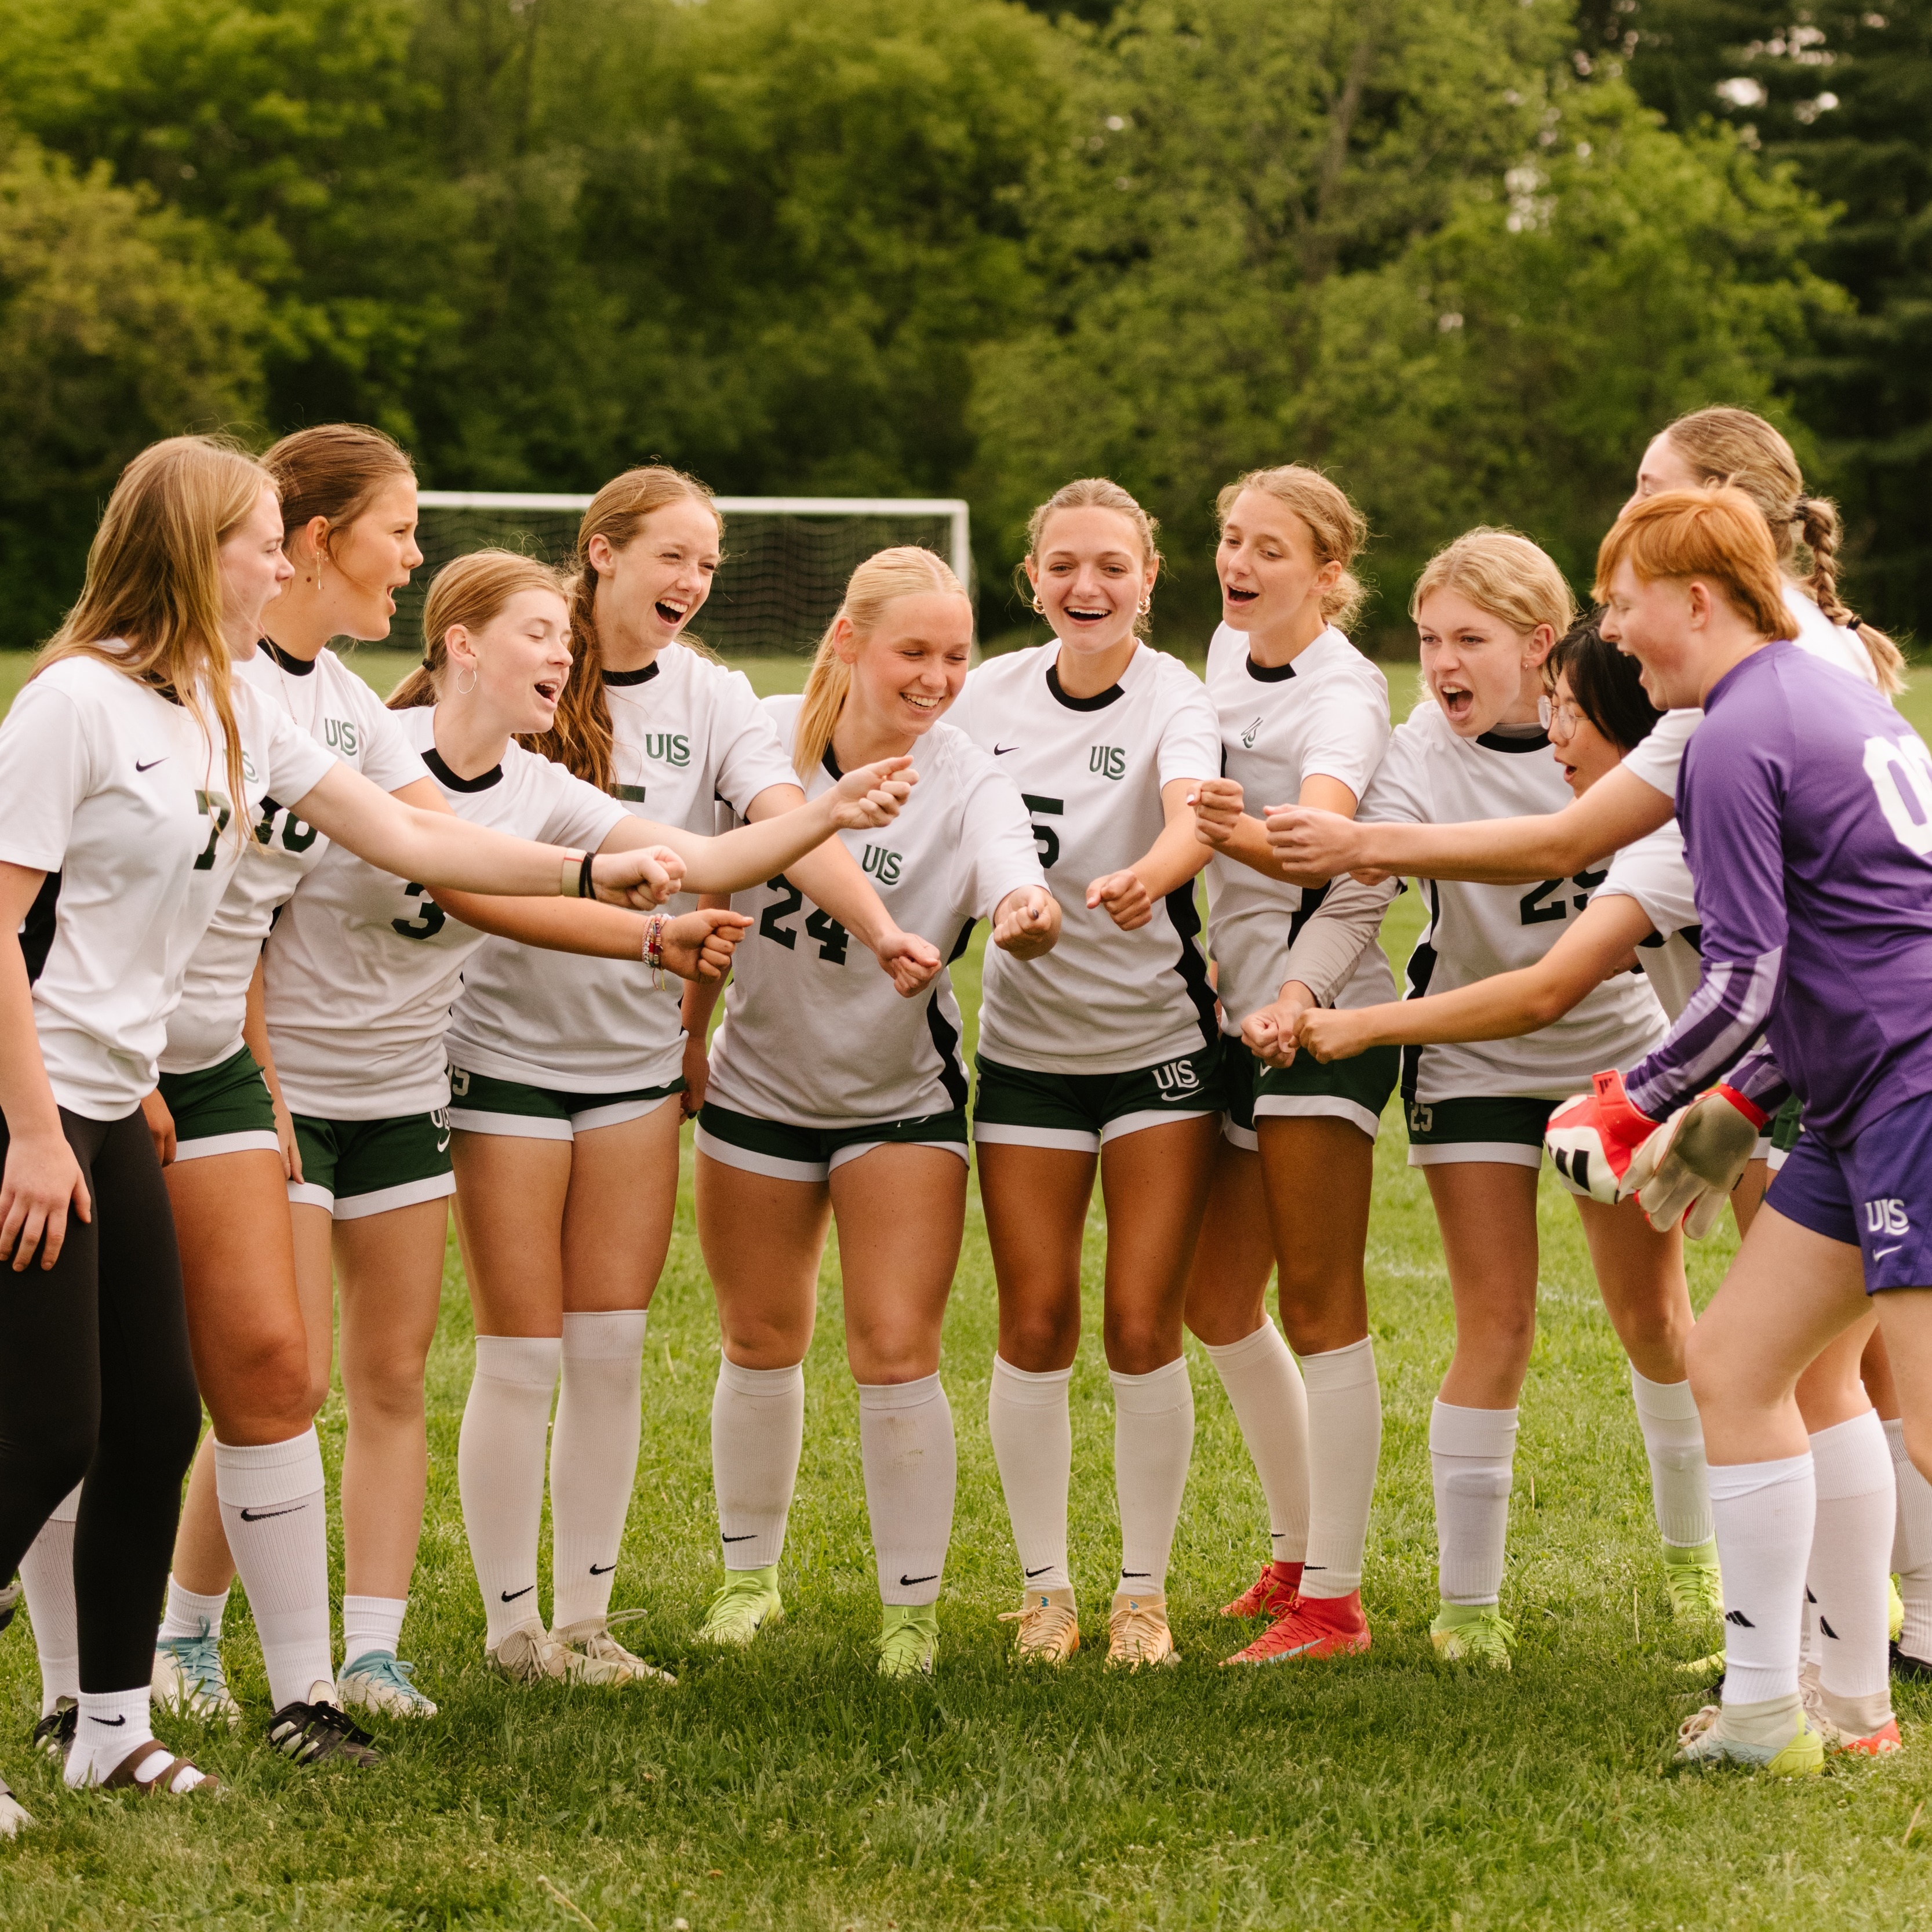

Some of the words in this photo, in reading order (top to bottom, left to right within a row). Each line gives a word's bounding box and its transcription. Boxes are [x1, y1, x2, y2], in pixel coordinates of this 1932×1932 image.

[325, 718, 358, 756] ULS
[645, 733, 690, 767] ULS
[1089, 745, 1126, 780] ULS
[192, 789, 231, 870] 7
[1021, 793, 1064, 869] 5
[862, 844, 903, 886] ULS
[391, 882, 446, 940] 3
[759, 873, 849, 966] 24
[1151, 1060, 1199, 1089] ULS
[1410, 1102, 1433, 1132] 25
[1865, 1199, 1910, 1236] ULS
